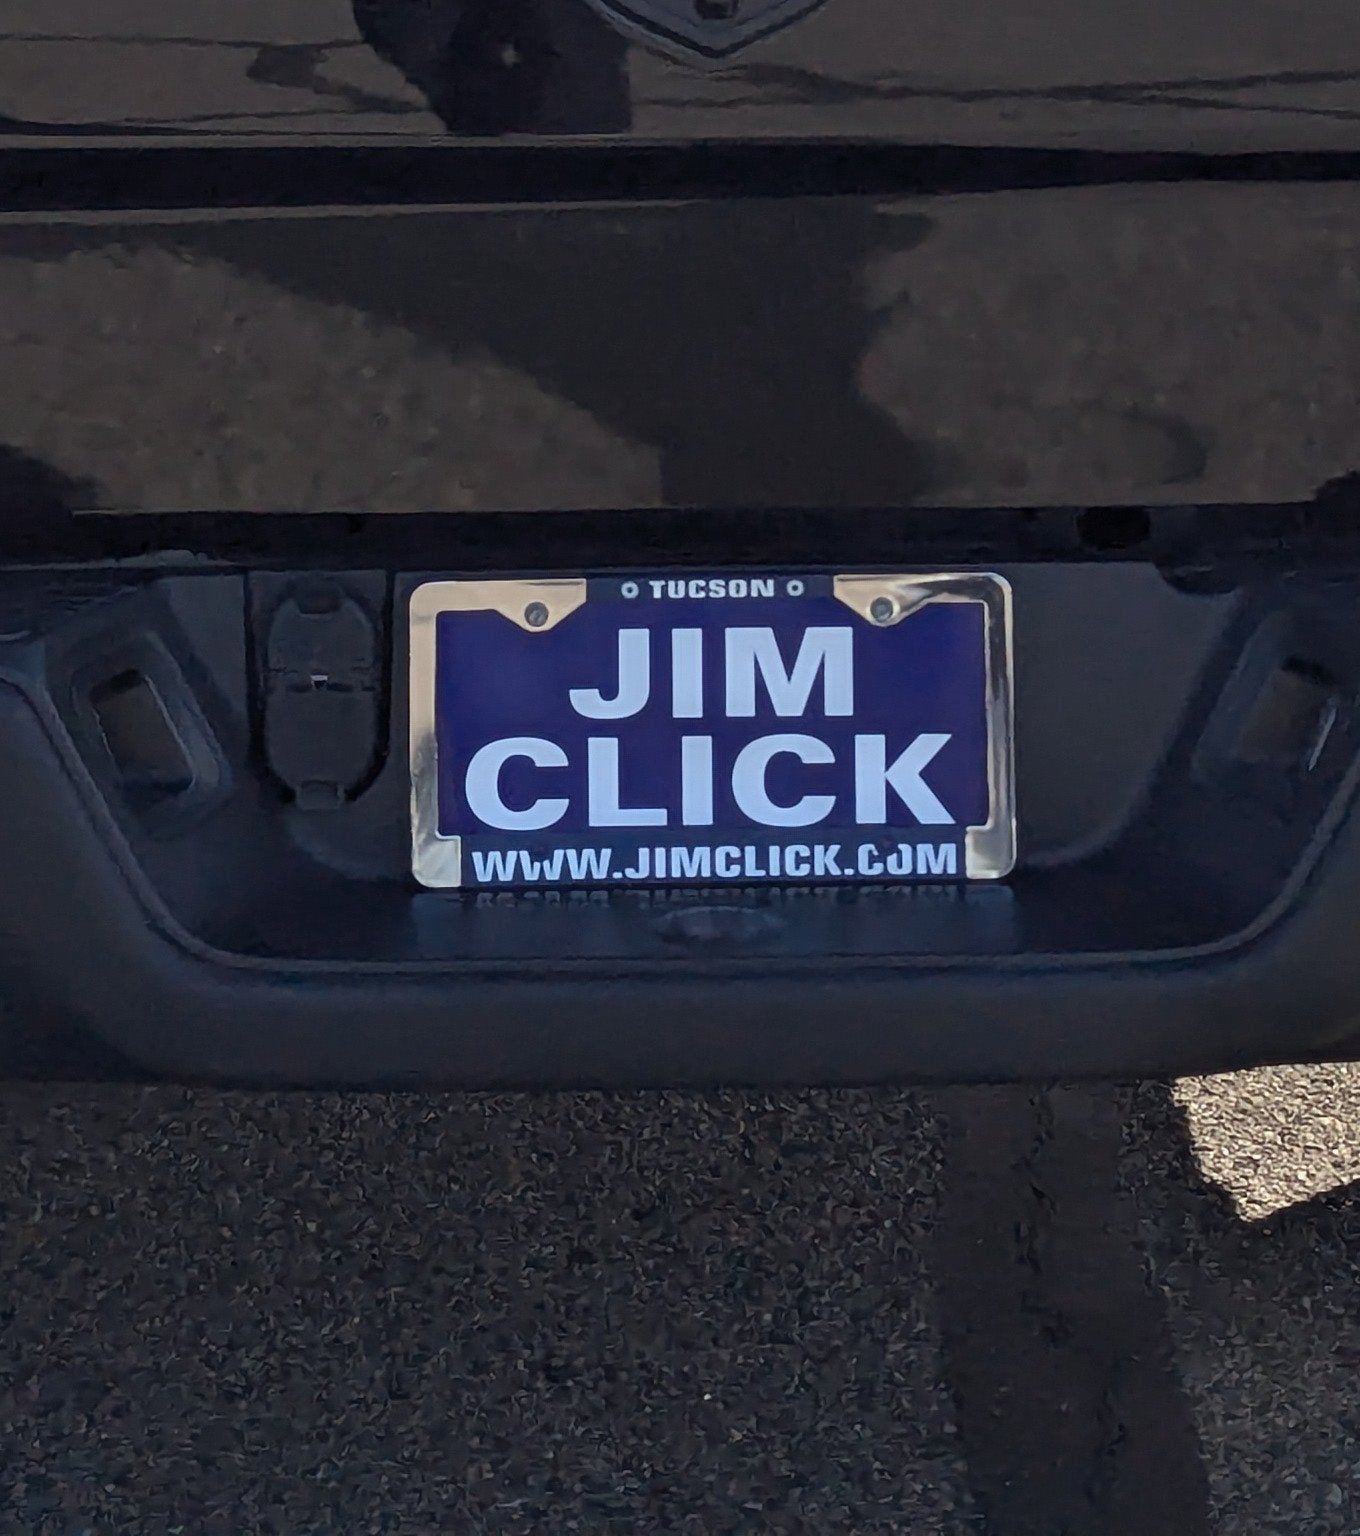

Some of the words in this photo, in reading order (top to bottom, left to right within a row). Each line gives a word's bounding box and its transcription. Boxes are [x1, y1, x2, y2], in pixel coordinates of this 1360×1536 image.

[648, 578, 776, 600] TUCSON
[569, 625, 855, 720] JIM
[464, 733, 957, 832] CLICK
[471, 841, 958, 883] WWW.JIMCLICK.COM
